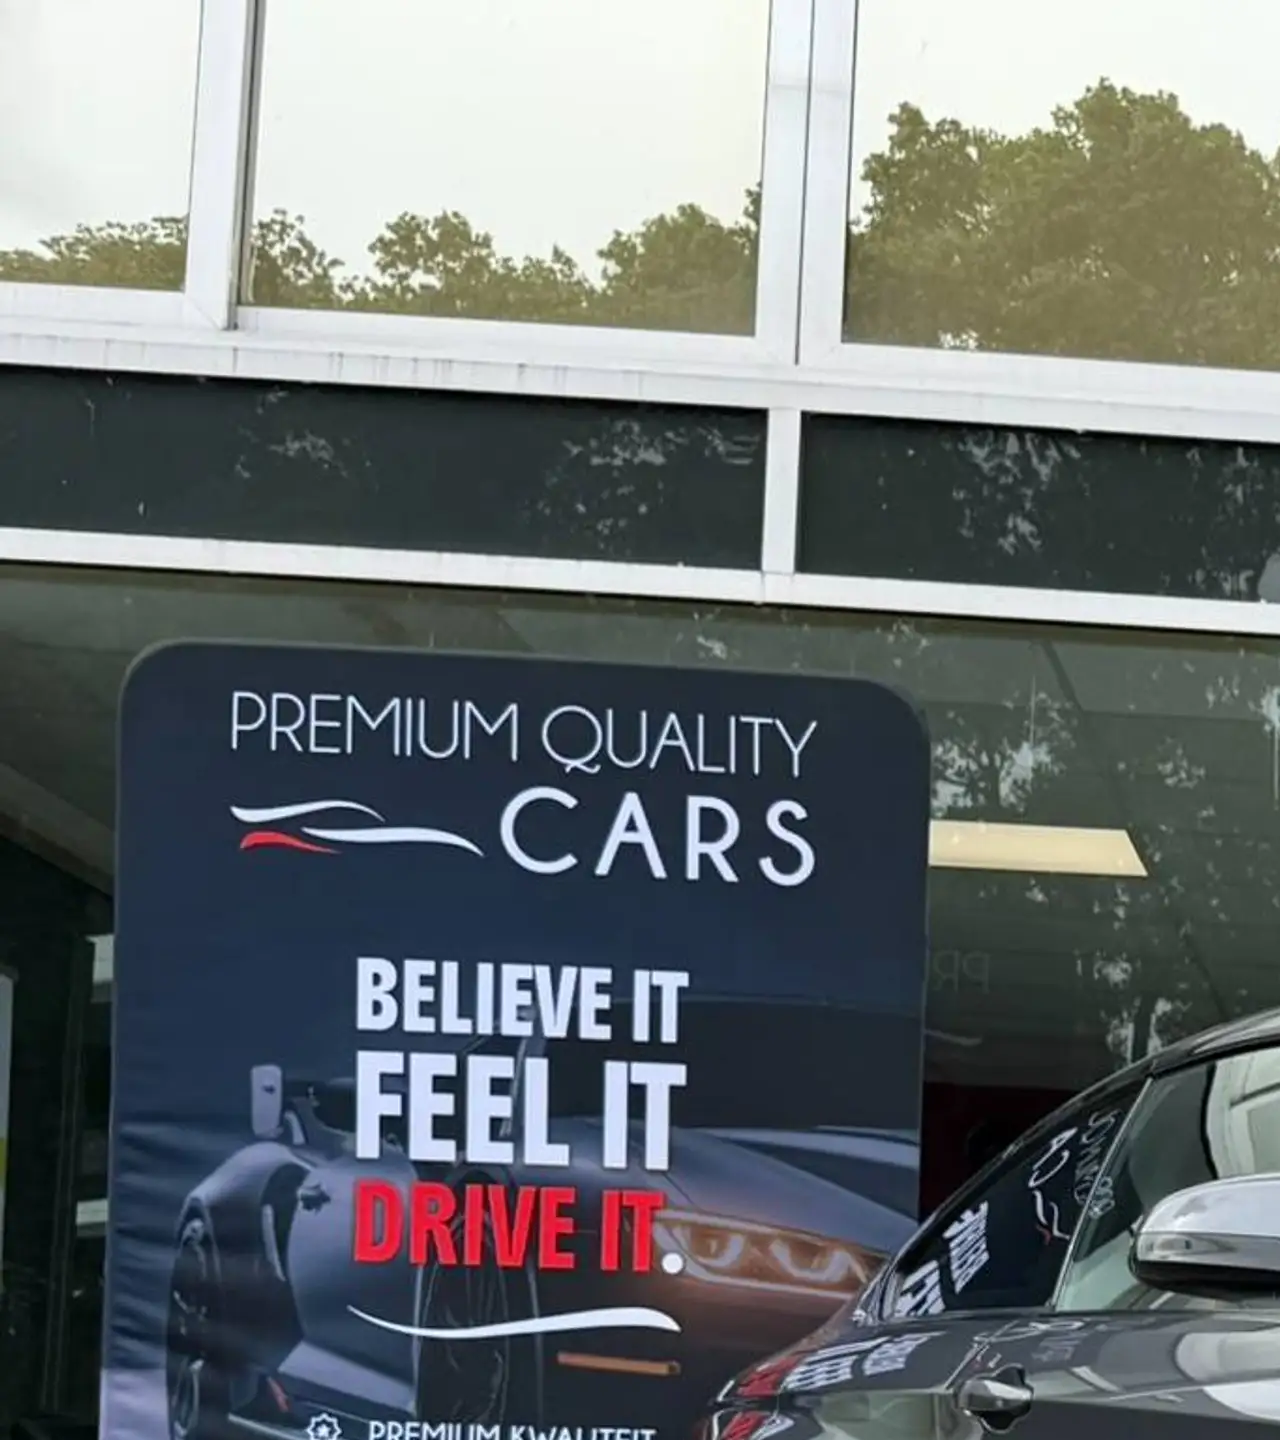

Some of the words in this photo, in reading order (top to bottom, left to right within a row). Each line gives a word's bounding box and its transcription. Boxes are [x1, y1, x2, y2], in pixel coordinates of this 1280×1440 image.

[232, 691, 519, 762] PREMIUM
[542, 705, 818, 778] QUALITY
[500, 786, 816, 887] CARS
[356, 957, 613, 1040] BELIEVE
[633, 970, 690, 1044] IT
[355, 1050, 571, 1167] FEEL
[602, 1060, 688, 1172] IT
[355, 1180, 575, 1271] DRIVE
